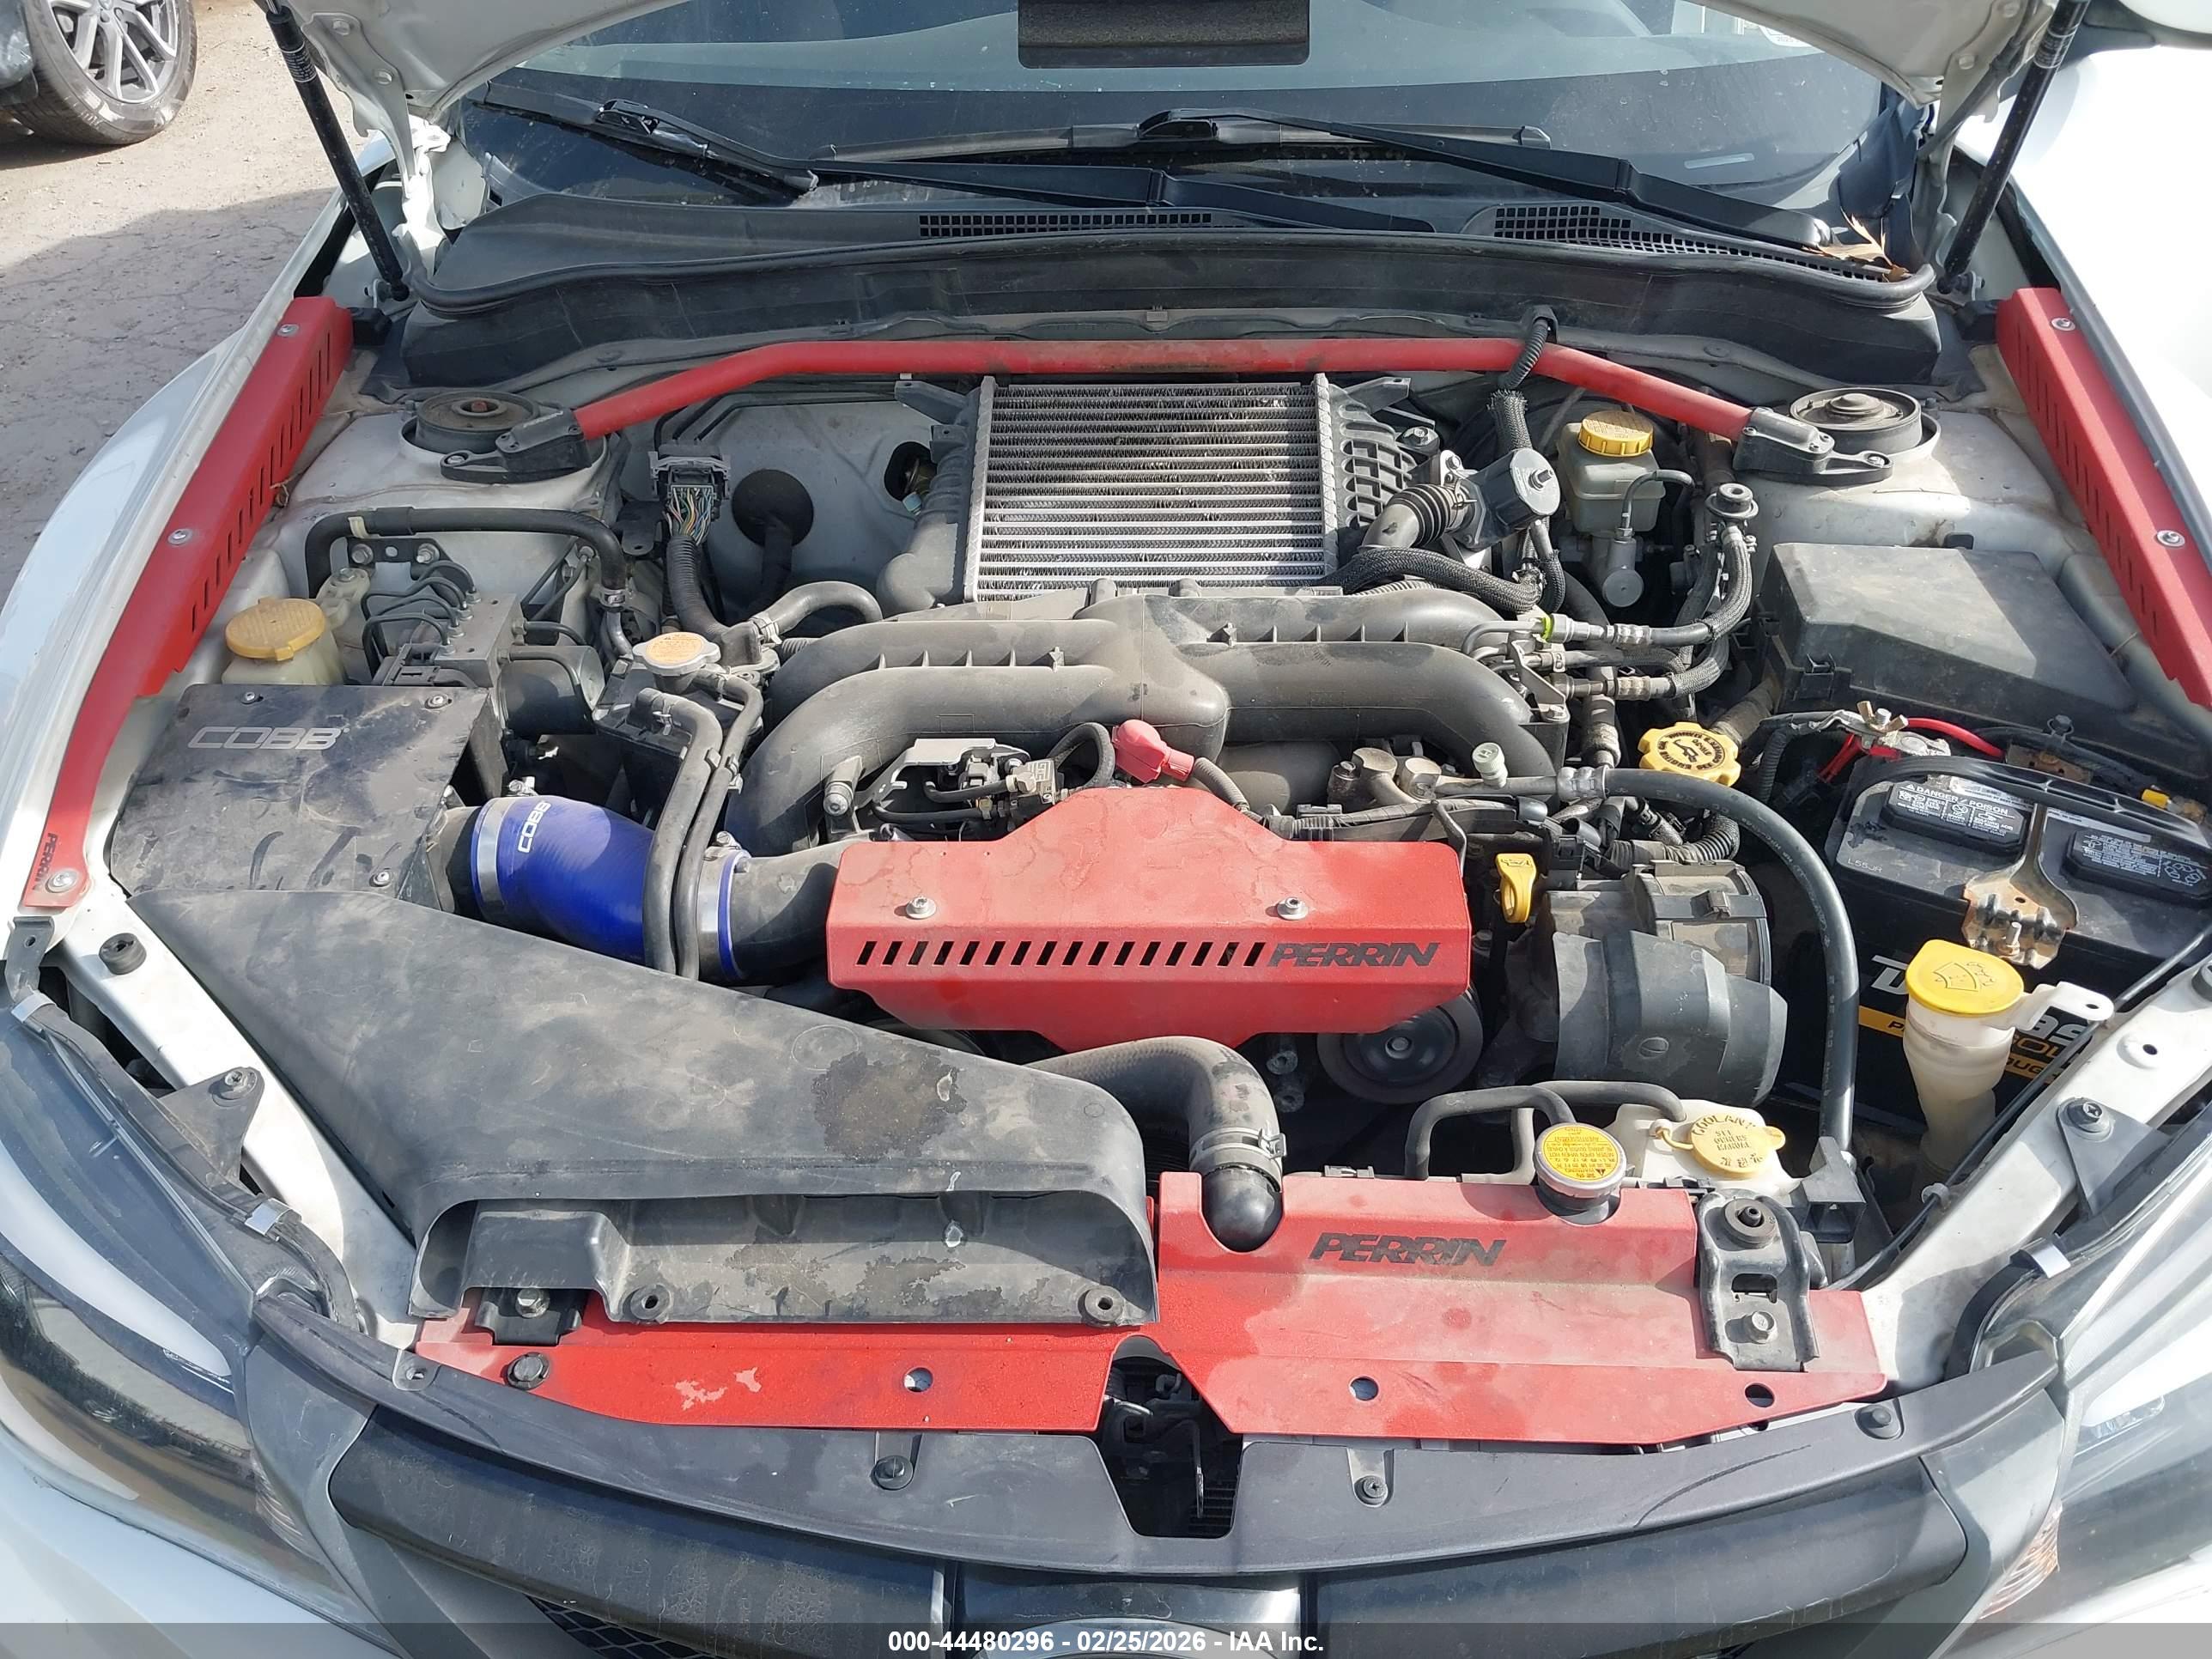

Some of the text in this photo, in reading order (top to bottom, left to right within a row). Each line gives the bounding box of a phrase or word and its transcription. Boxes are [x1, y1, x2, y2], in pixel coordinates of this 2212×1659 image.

[188, 726, 343, 750] COBB
[1916, 786, 1959, 802] DANGER
[1969, 800, 2008, 815] POISON
[518, 802, 551, 853] COBB
[1267, 942, 1441, 967] PERRIN
[1308, 1232, 1506, 1266] PERRIN
